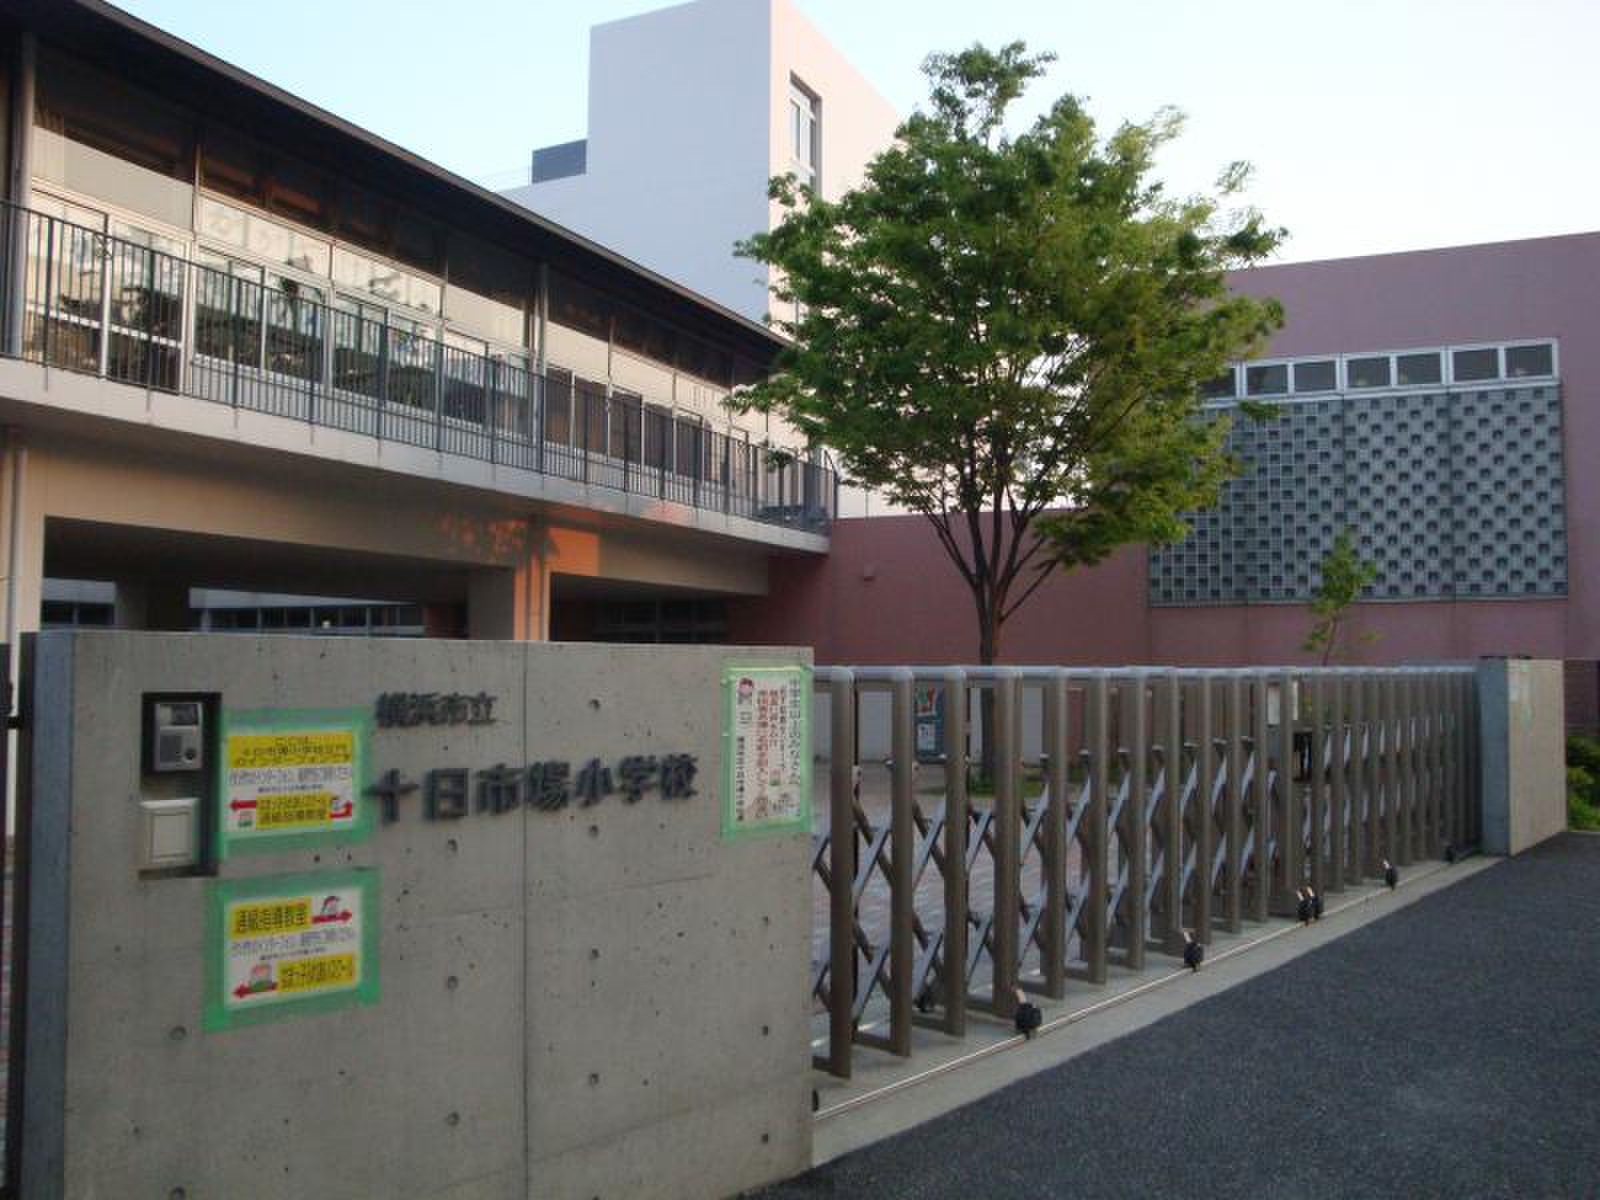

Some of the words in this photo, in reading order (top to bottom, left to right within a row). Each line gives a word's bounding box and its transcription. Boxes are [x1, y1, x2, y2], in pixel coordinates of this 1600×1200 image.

[366, 754, 698, 824] 十日市場小学校
